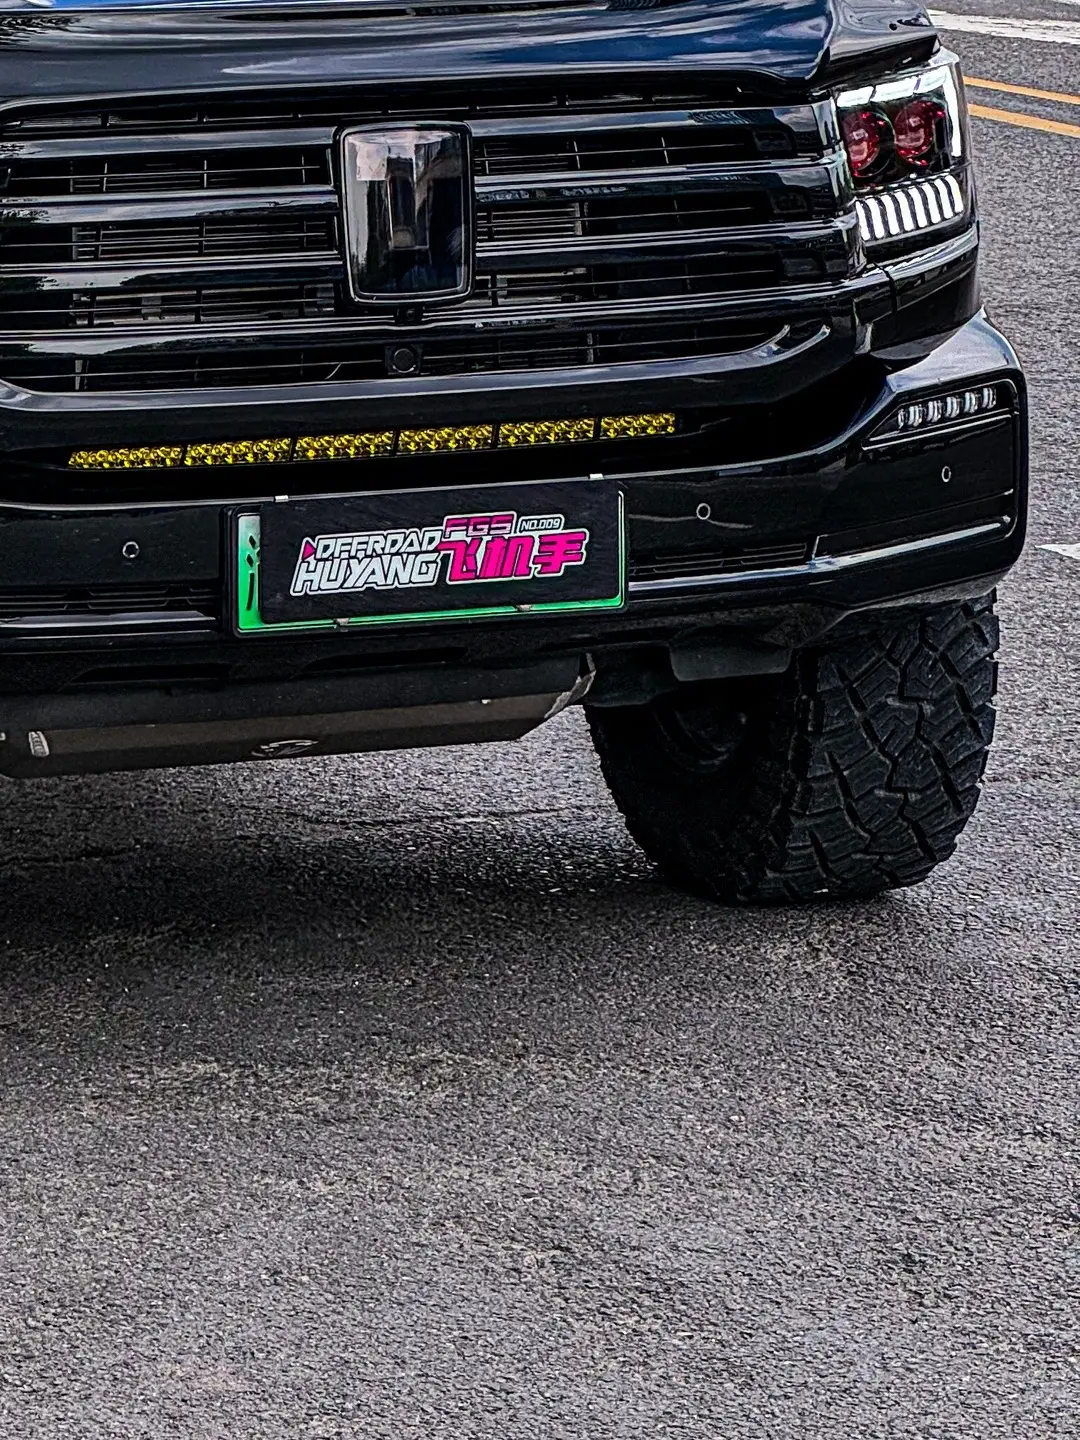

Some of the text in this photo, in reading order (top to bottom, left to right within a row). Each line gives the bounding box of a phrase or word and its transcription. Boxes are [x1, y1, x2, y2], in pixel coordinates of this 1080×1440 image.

[444, 514, 560, 538] FGS NO.009
[315, 530, 443, 560] OFFROAD
[436, 531, 587, 582] 飞机手
[293, 553, 440, 593] HUYANG
